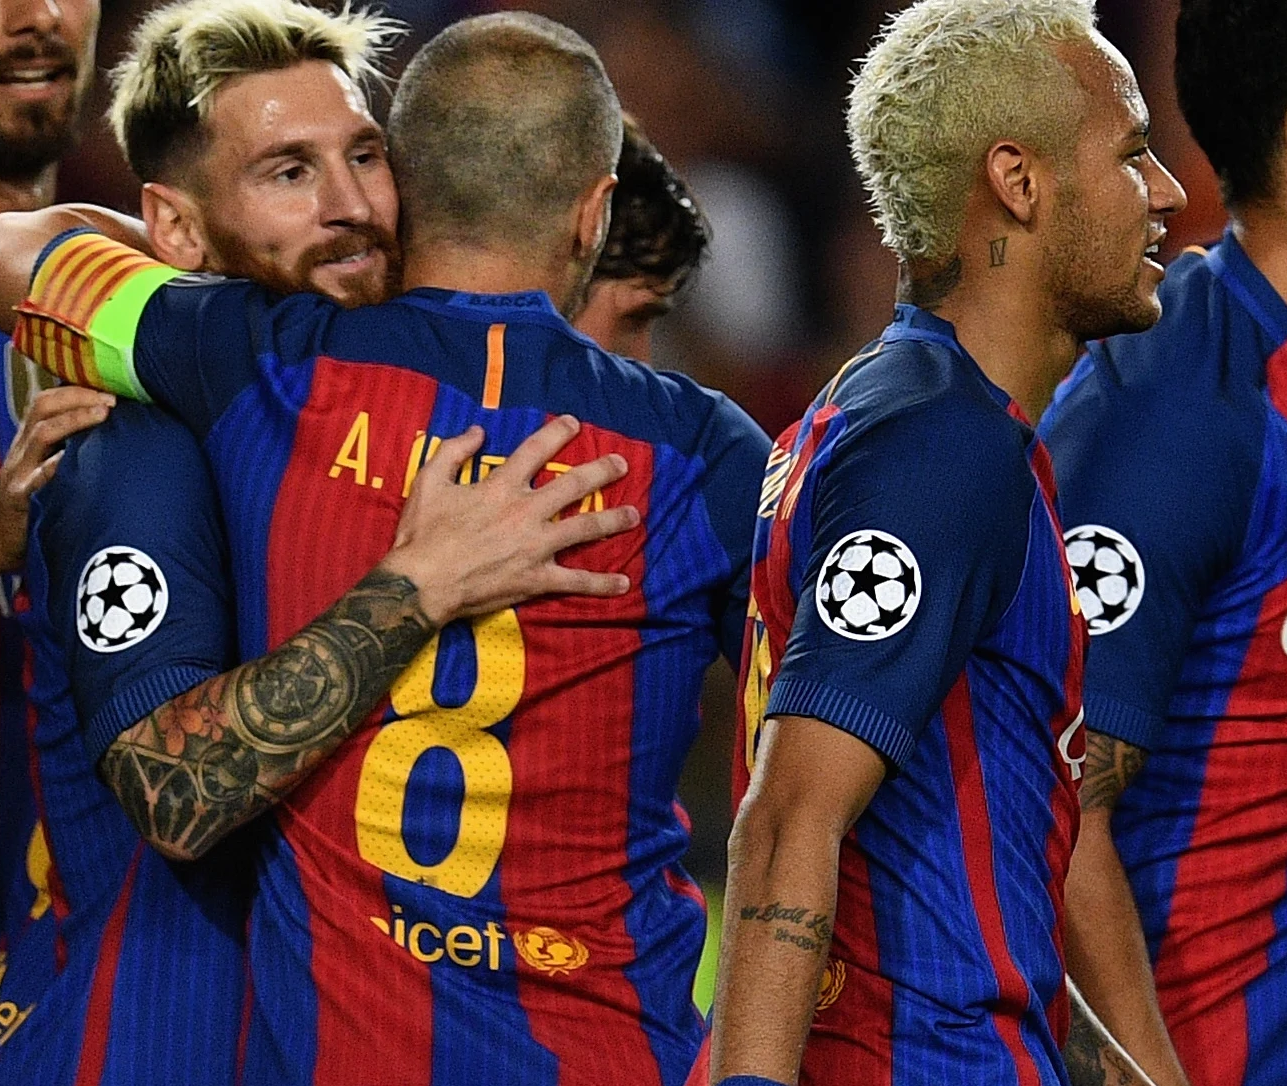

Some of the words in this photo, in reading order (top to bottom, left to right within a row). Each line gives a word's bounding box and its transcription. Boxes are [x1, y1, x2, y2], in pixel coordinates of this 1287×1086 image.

[328, 411, 384, 489] A.
[354, 607, 526, 898] 8
[369, 904, 506, 971] icef
